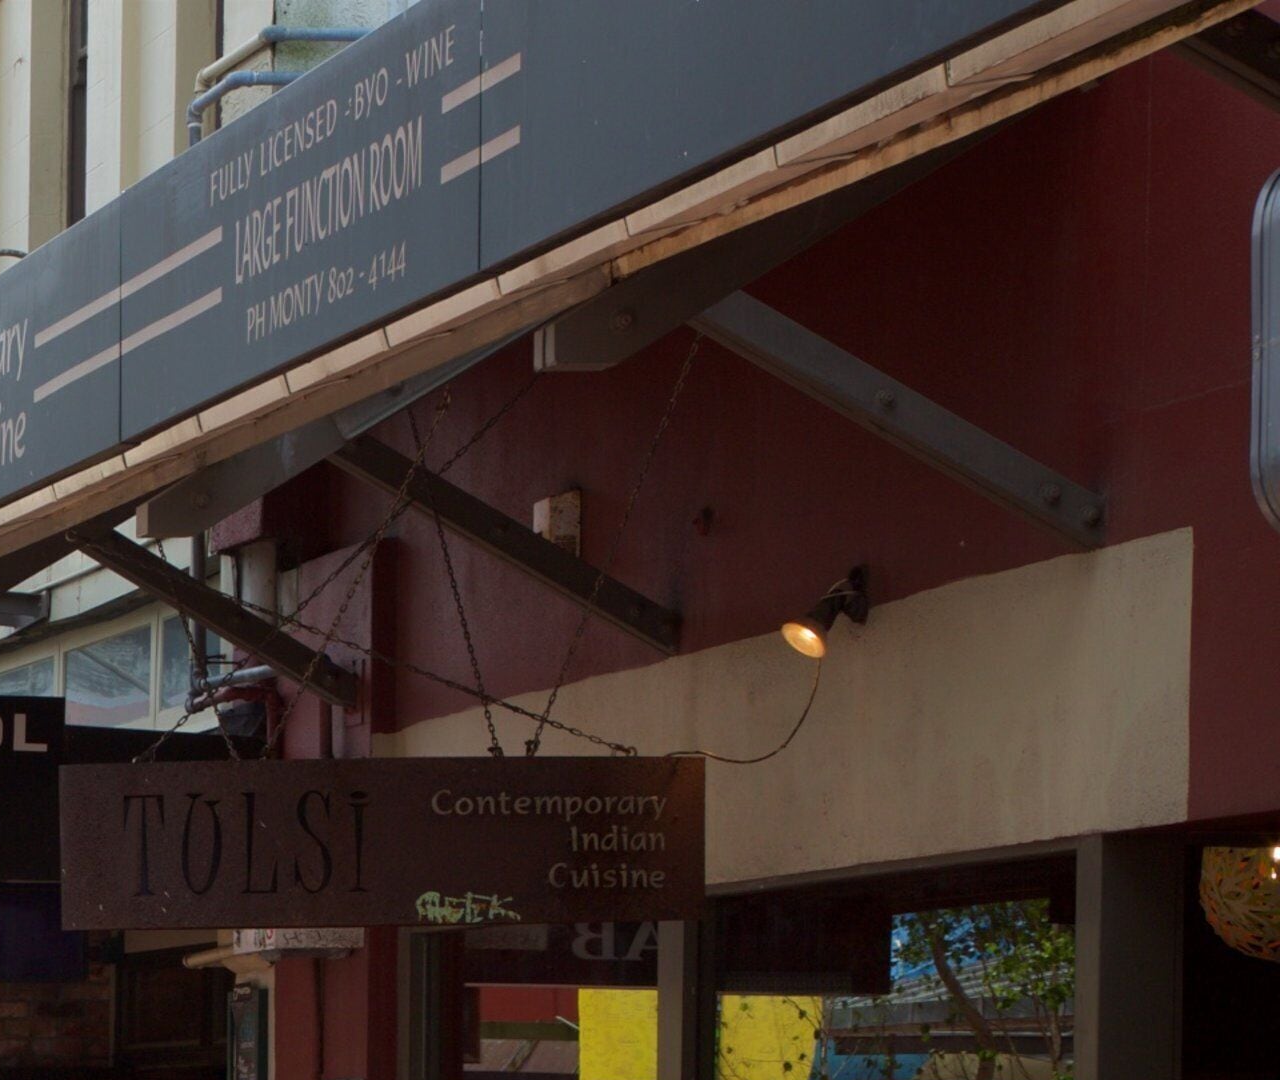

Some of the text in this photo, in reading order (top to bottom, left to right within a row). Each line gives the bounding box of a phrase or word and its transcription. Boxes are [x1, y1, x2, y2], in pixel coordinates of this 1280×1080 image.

[210, 149, 253, 206] FULLY
[261, 99, 337, 176] LICENSED
[355, 67, 388, 120] BYO
[406, 25, 456, 88] WINE
[235, 114, 423, 284] LARGE FUNCTION ROOM
[246, 304, 265, 344] PH
[269, 271, 324, 332] MONTY
[328, 266, 354, 304] 802
[369, 240, 406, 290] 4144
[431, 789, 667, 822] Contemporary
[570, 825, 665, 852] Indian
[549, 862, 666, 888] Cuisine
